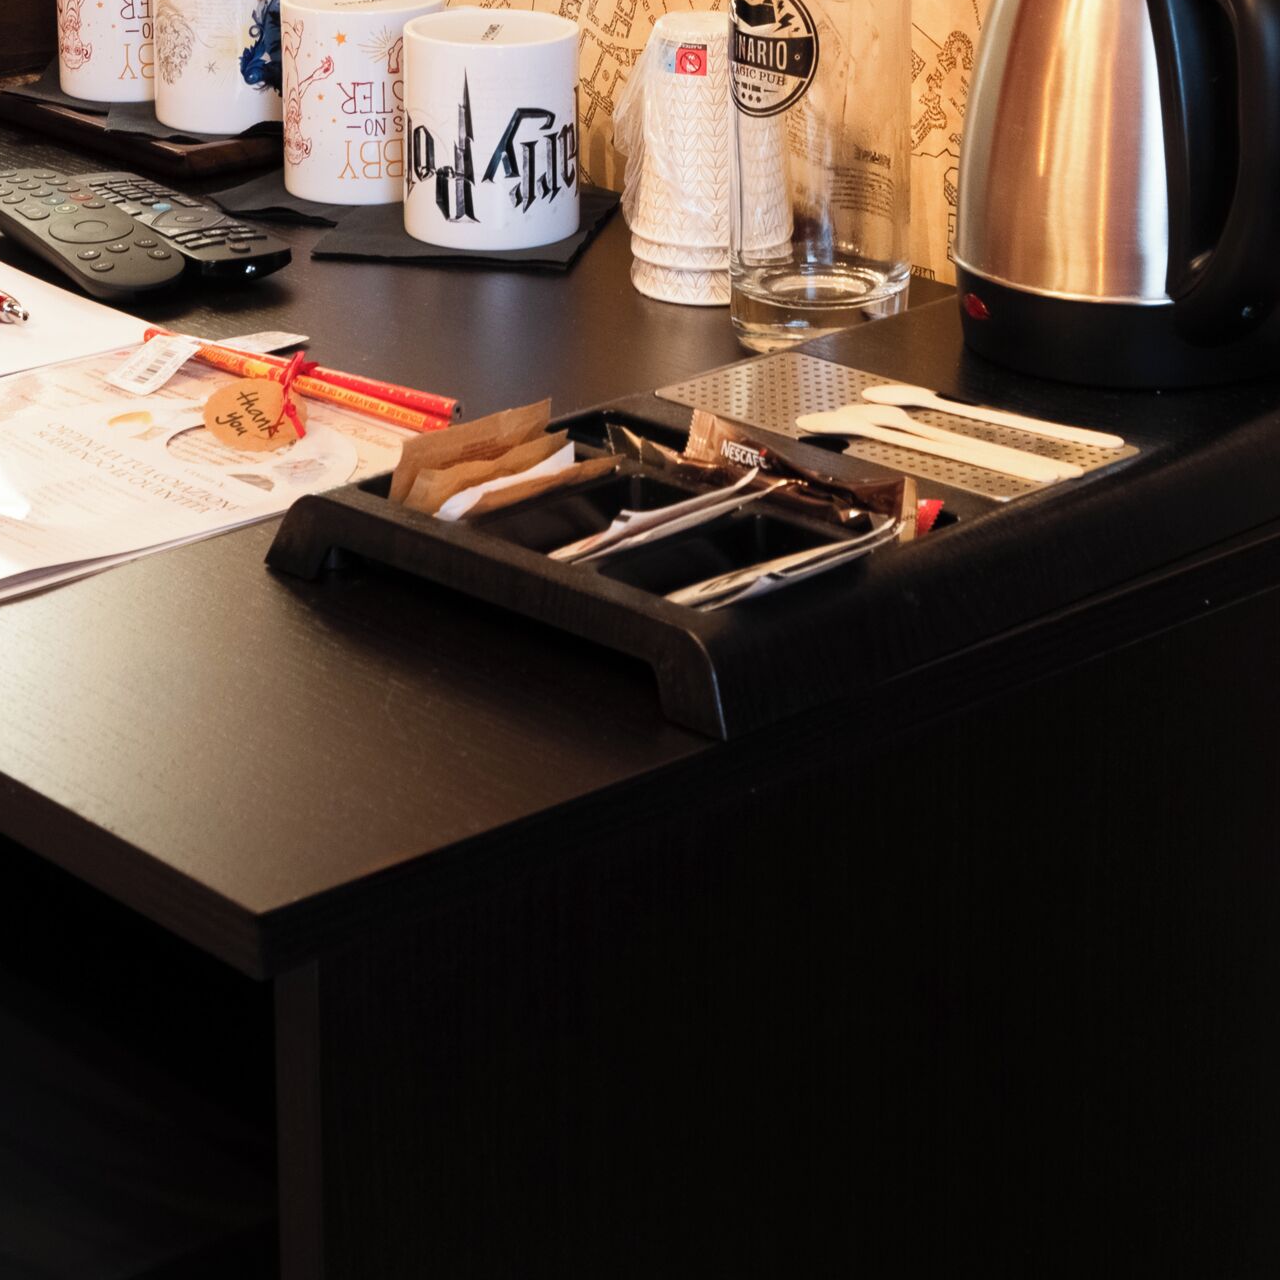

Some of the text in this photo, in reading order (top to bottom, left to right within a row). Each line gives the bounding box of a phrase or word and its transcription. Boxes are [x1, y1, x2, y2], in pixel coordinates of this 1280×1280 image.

[735, 32, 788, 70] INARIO
[759, 71, 785, 86] PUB
[336, 80, 404, 115] STER
[337, 138, 404, 180] BBY
[215, 411, 248, 437] you
